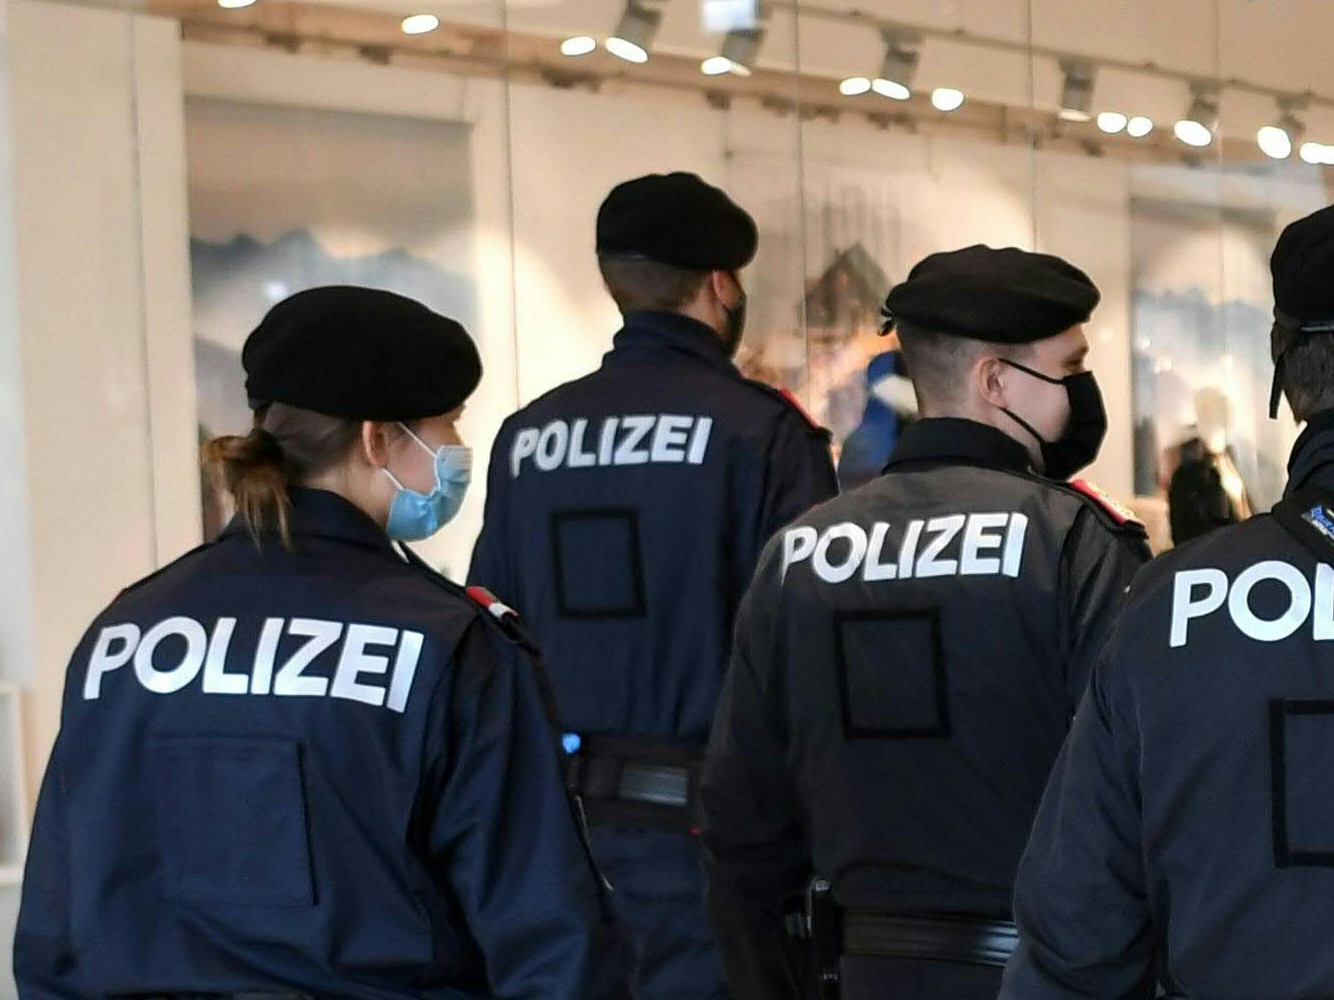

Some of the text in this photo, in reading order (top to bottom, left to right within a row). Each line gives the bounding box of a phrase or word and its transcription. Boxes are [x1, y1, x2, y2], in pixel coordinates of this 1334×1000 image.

[511, 414, 713, 477] POLIZEI
[781, 511, 1029, 584] POLIZEI
[83, 616, 425, 713] POLIZEI
